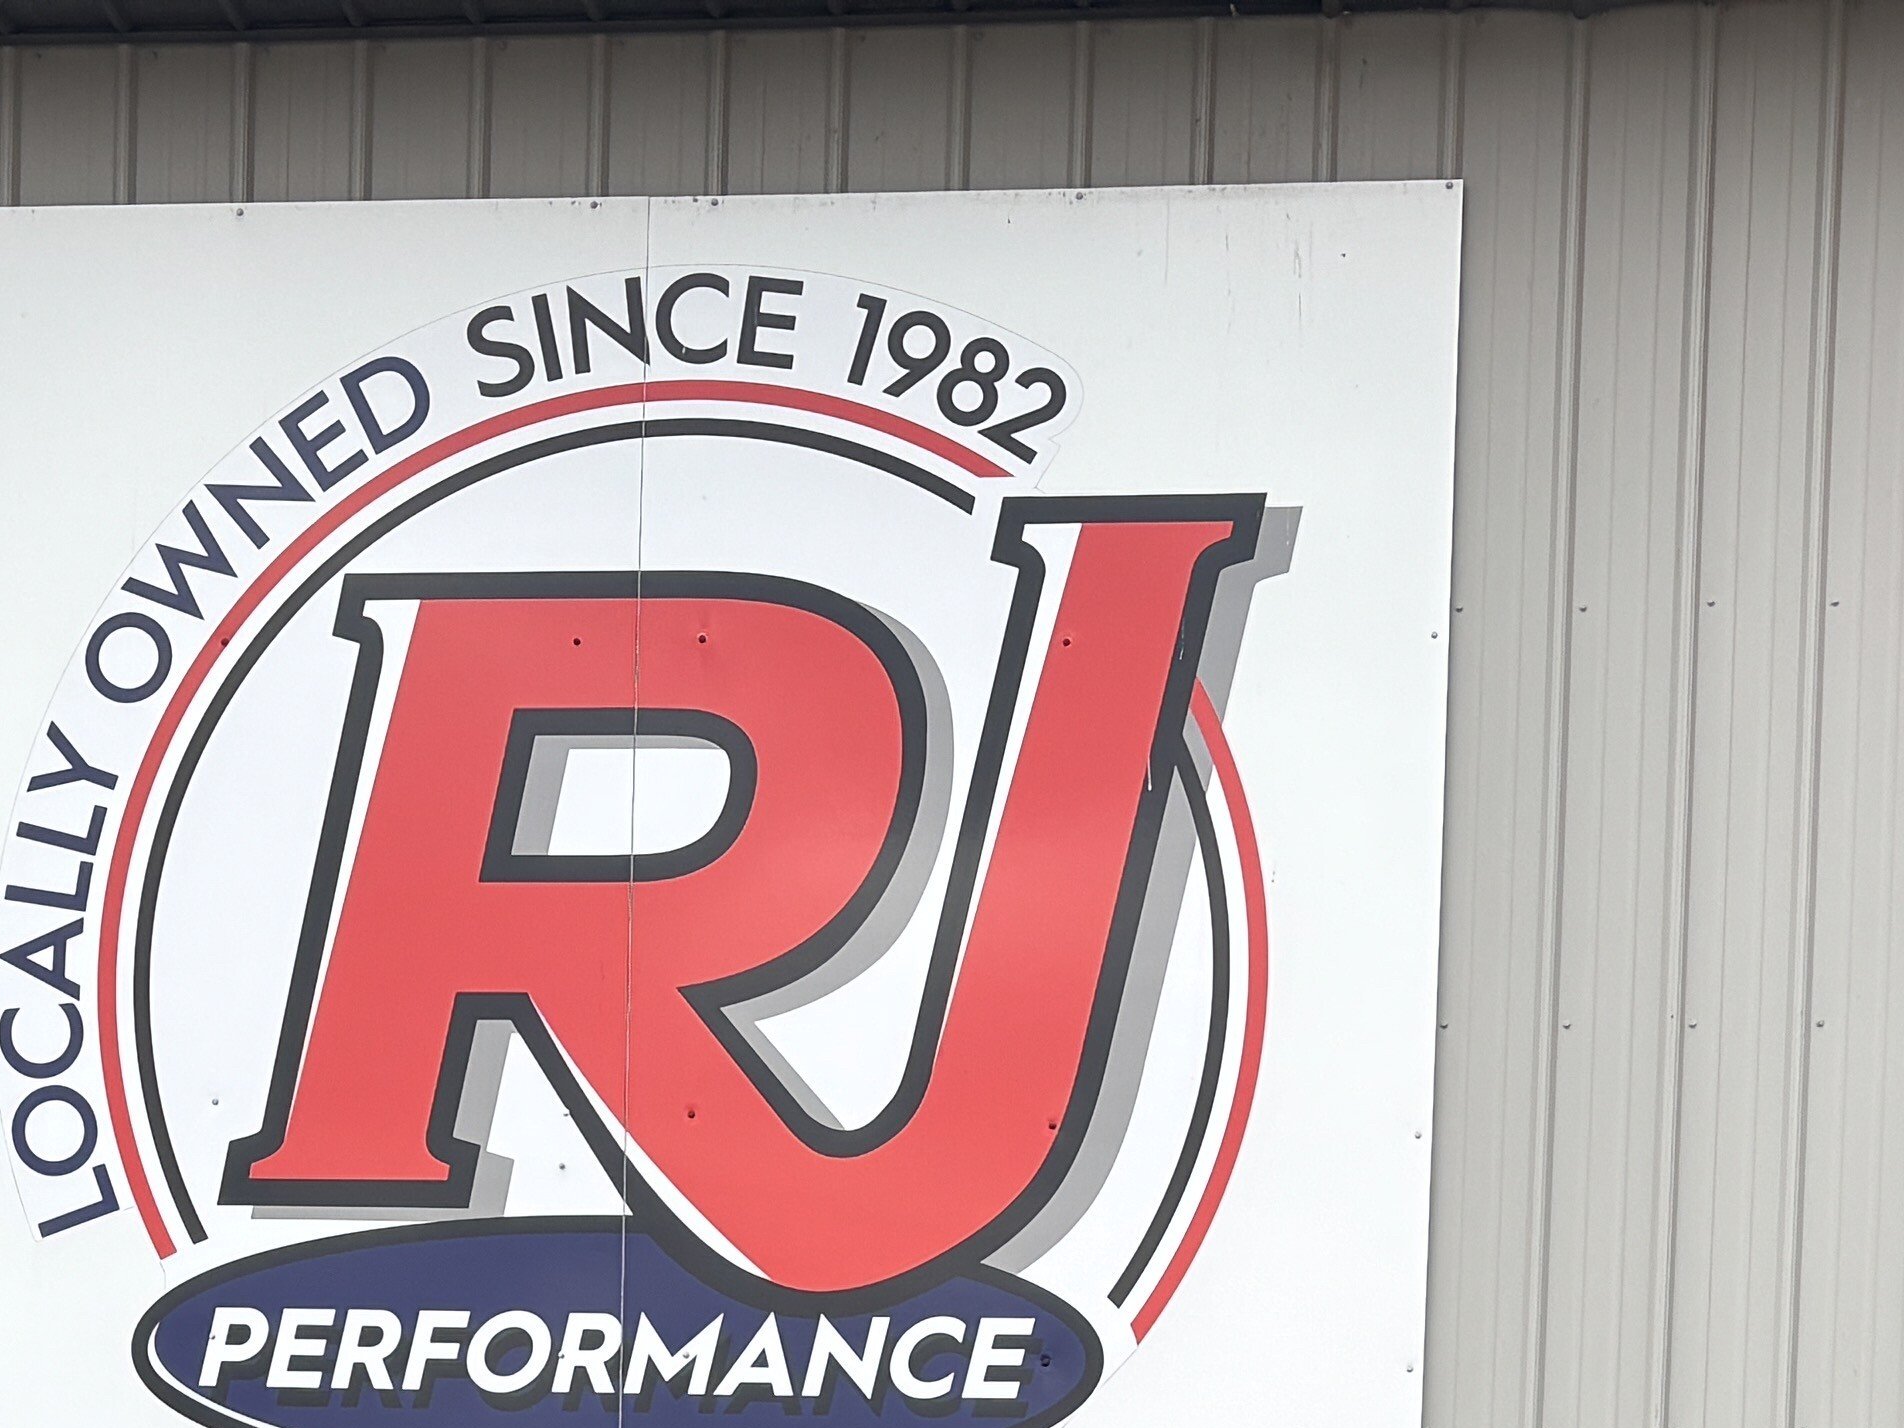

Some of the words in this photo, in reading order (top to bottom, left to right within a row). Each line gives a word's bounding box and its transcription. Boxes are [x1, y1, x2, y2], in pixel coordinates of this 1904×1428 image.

[85, 356, 431, 704] OWNED
[466, 273, 804, 397] SINCE
[846, 293, 1068, 464] 1982
[217, 491, 1271, 1315] RJ
[198, 1306, 1036, 1400] PERFORMANCE
